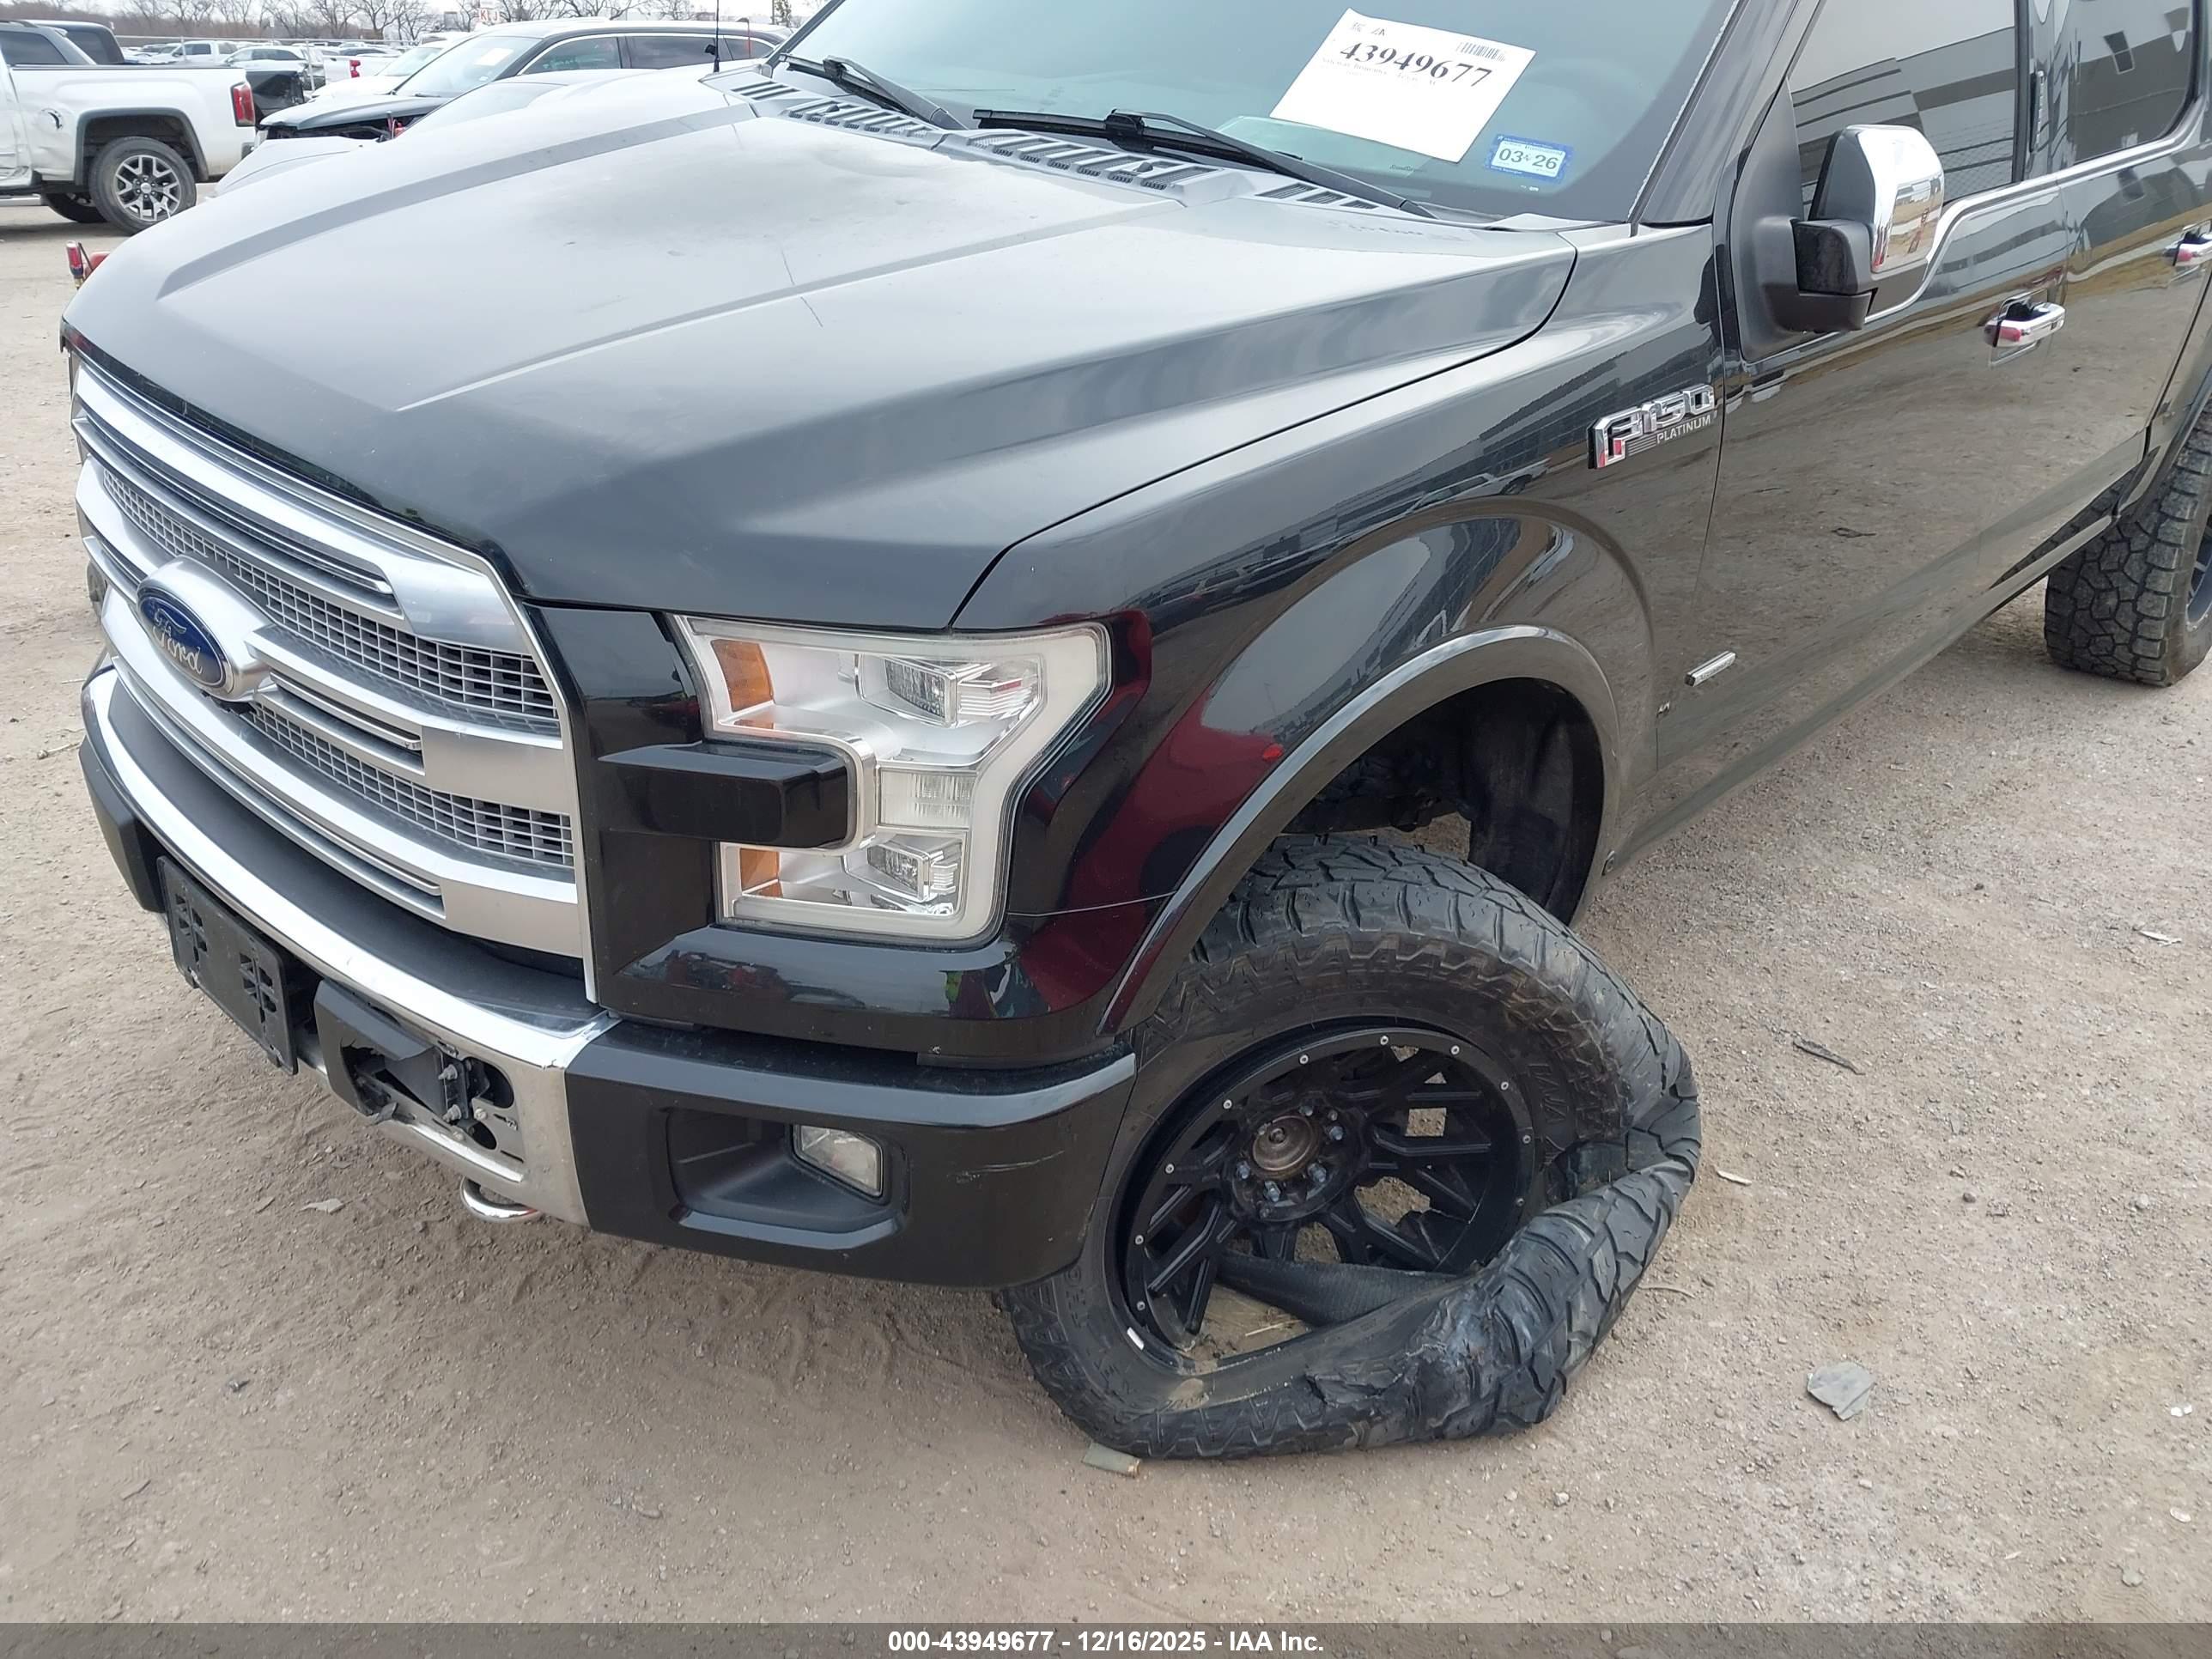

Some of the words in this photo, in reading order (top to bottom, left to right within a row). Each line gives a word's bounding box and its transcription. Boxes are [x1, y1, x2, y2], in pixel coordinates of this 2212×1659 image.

[1340, 42, 1492, 87] 43949677
[1498, 148, 1524, 163] 03
[1531, 154, 1559, 170] 26
[1656, 413, 1711, 444] PLATINUM
[152, 607, 204, 675] Ford
